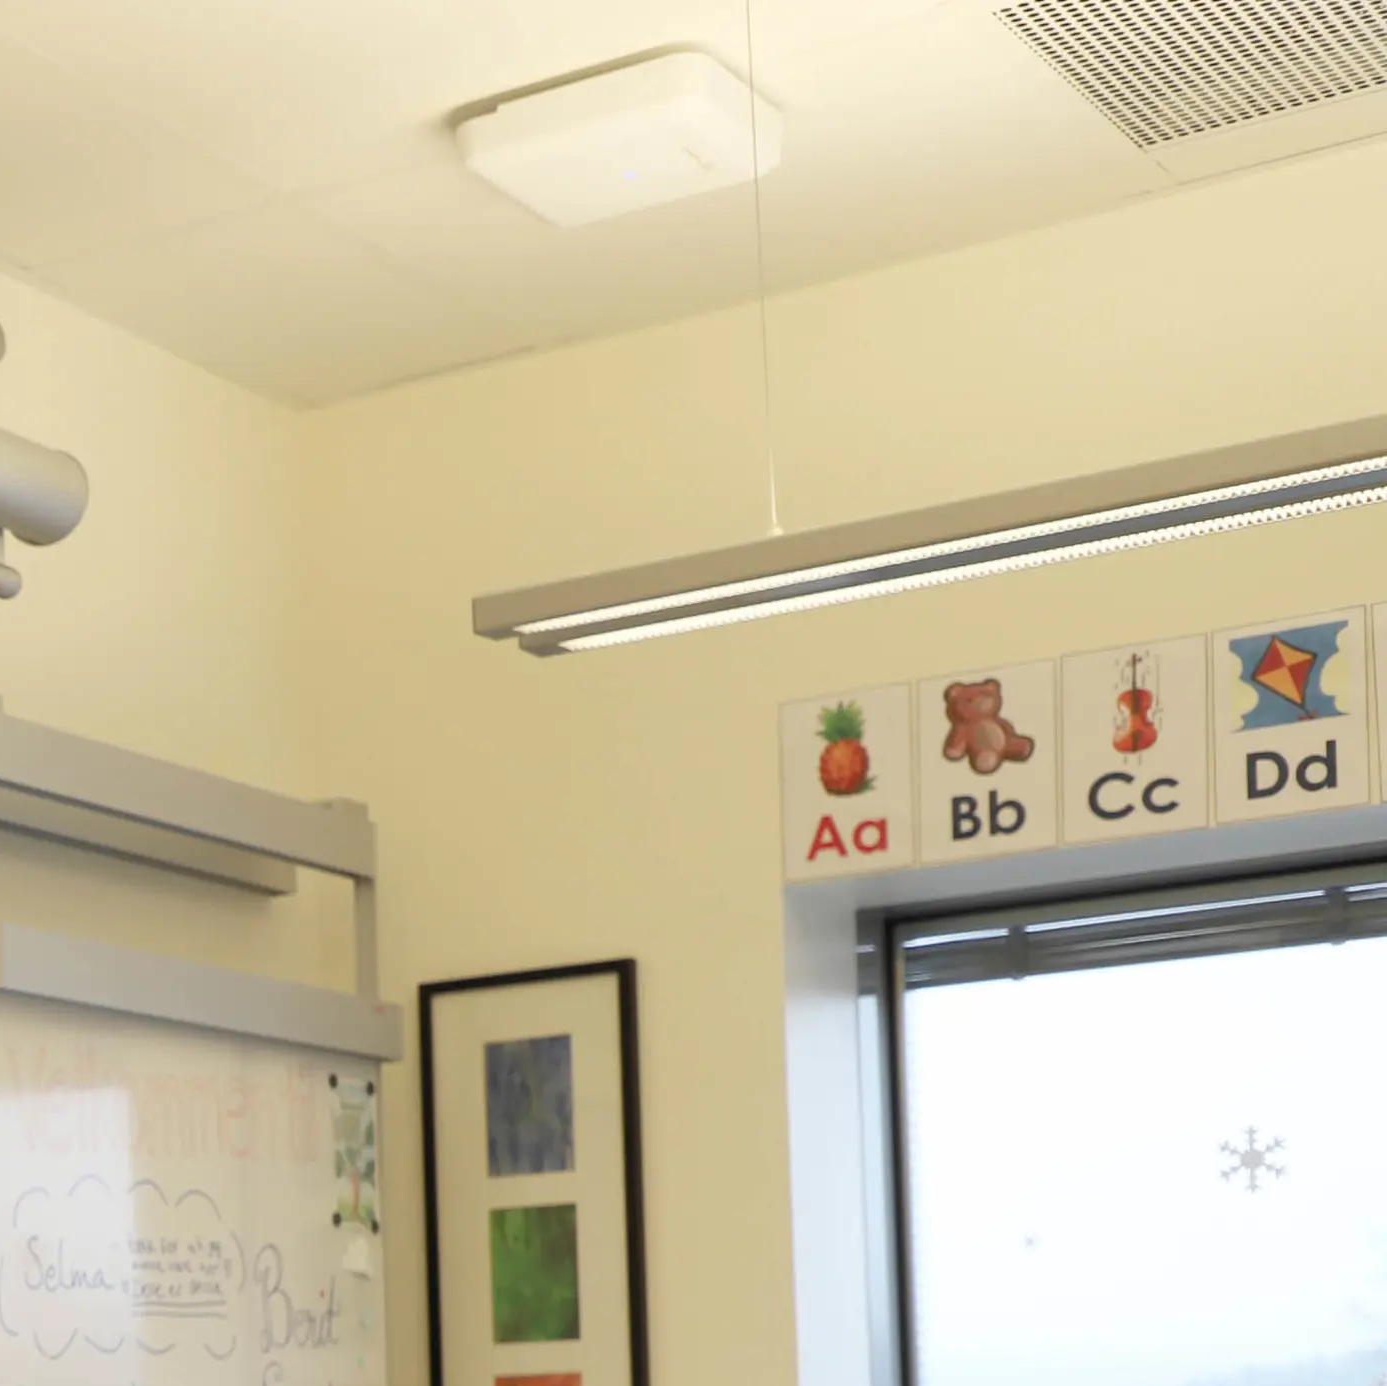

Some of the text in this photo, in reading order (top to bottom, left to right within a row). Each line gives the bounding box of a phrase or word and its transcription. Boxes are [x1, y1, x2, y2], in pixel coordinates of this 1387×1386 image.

[808, 740, 1338, 861] Aa Bb Cc Dd
[24, 1235, 115, 1293] Selma
